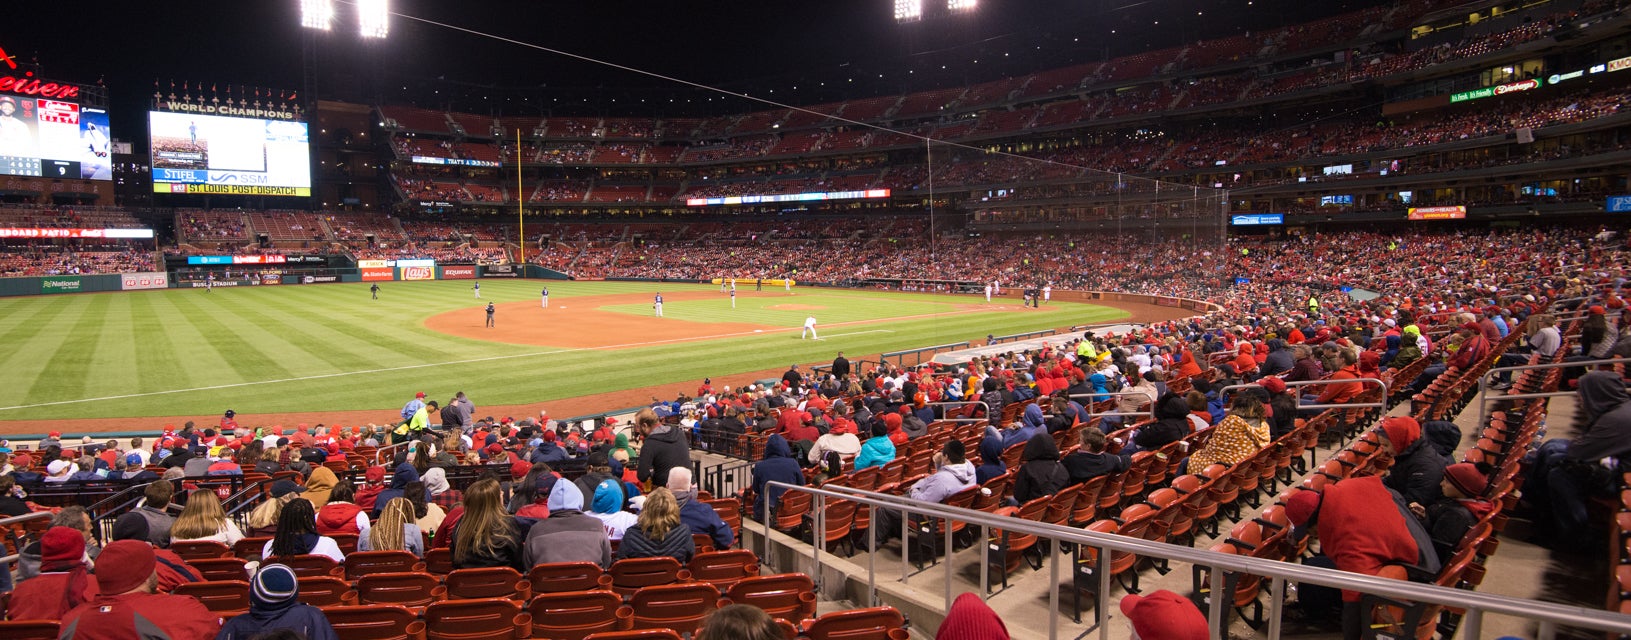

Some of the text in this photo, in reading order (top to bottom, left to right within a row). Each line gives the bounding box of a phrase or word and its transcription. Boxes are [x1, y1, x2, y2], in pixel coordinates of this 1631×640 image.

[167, 101, 293, 119] WORLD CHAMPIONS
[59, 166, 66, 176] 9
[164, 168, 197, 179] STIFEL
[241, 174, 267, 184] SSM
[204, 184, 229, 193] LOUIS
[41, 229, 70, 237] PATIO
